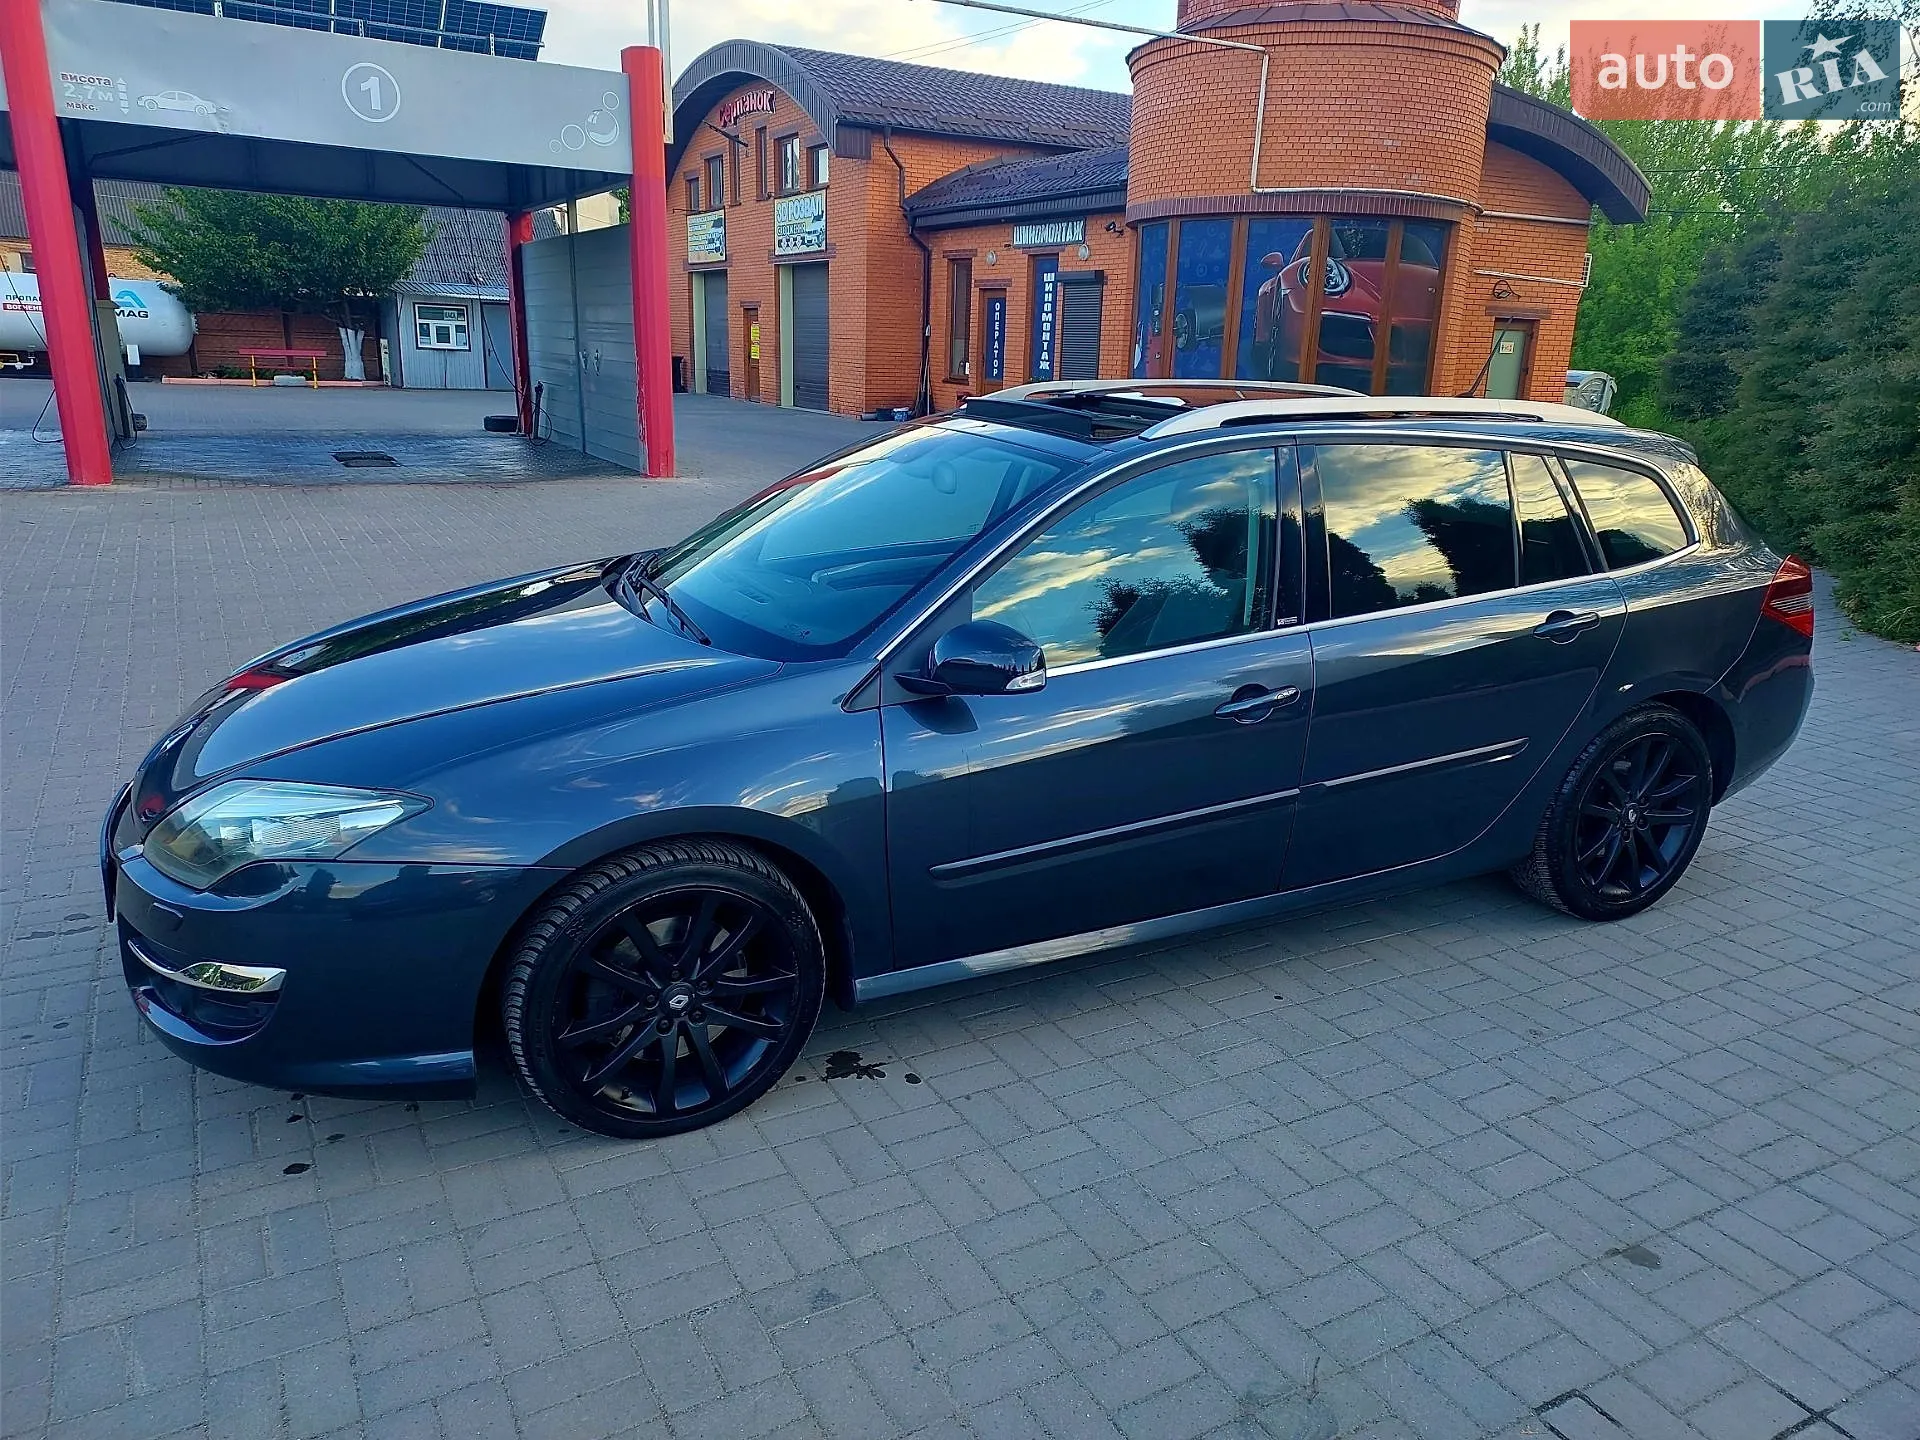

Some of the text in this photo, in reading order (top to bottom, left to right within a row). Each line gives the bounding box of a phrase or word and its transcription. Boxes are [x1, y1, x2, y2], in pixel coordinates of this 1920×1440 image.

[360, 76, 381, 111] 1
[788, 193, 822, 221] РОЗВАЛ
[1014, 221, 1084, 245] ШИНОМОНТАЖ
[1039, 272, 1055, 370] ШИНОМОНТАЖ
[993, 302, 1001, 377] ОПЕРАТОР
